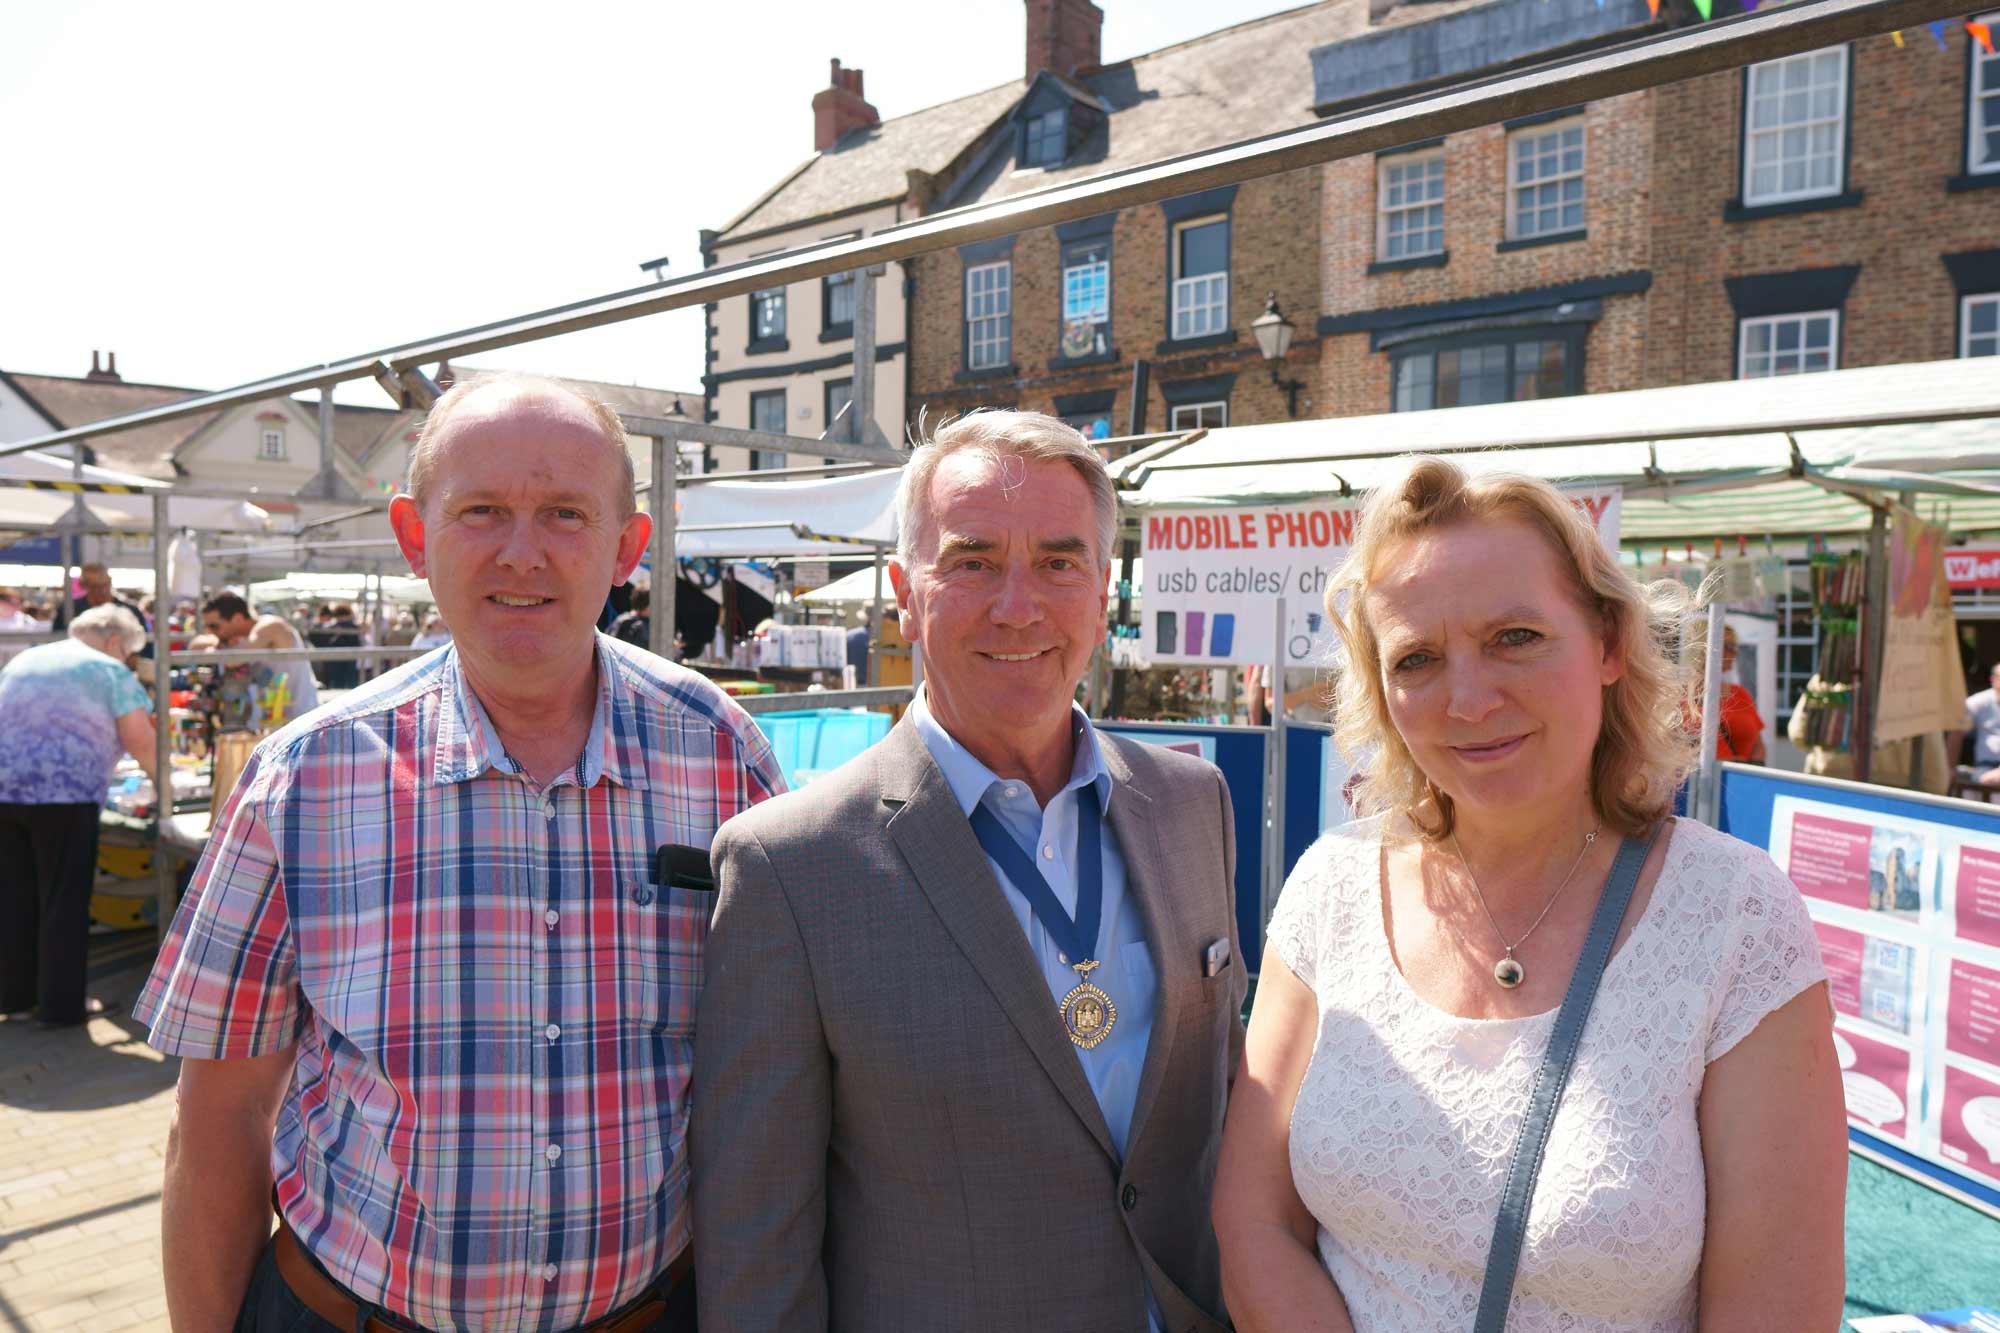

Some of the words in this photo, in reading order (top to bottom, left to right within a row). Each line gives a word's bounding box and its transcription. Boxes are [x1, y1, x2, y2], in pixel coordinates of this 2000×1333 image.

[1148, 513, 1258, 550] MOBILE
[1265, 510, 1358, 548] PHON
[1157, 566, 1198, 593] usb
[1205, 565, 1292, 597] cables/
